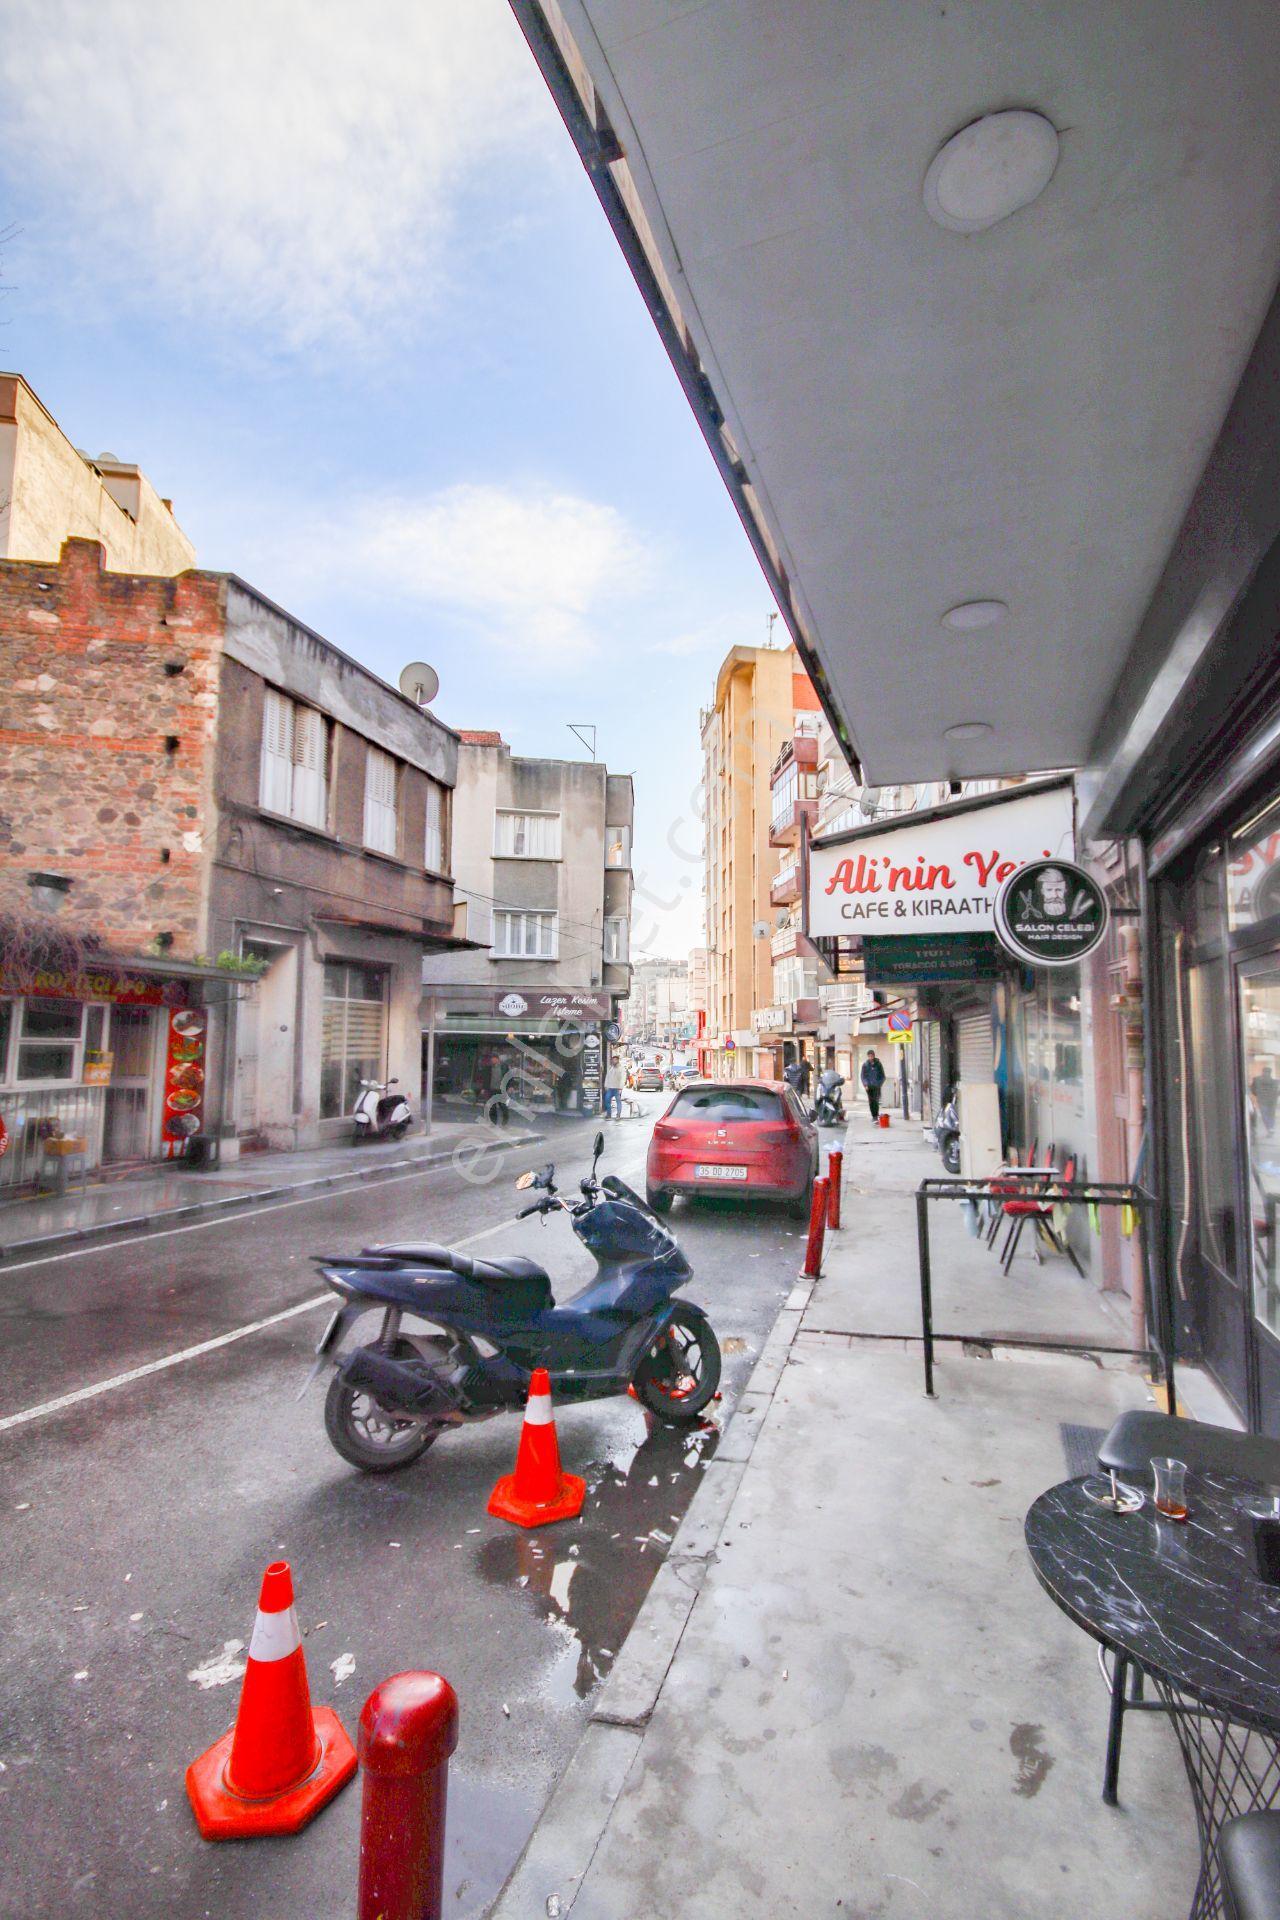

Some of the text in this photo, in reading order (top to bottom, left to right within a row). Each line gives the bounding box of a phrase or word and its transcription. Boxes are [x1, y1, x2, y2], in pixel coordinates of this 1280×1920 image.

[824, 849, 1052, 896] Ali'nin Ye
[841, 901, 889, 919] CAFE
[894, 901, 907, 918] &
[1015, 923, 1054, 932] SALON
[700, 1166, 710, 1177] 35
[725, 1167, 745, 1177] 2705
